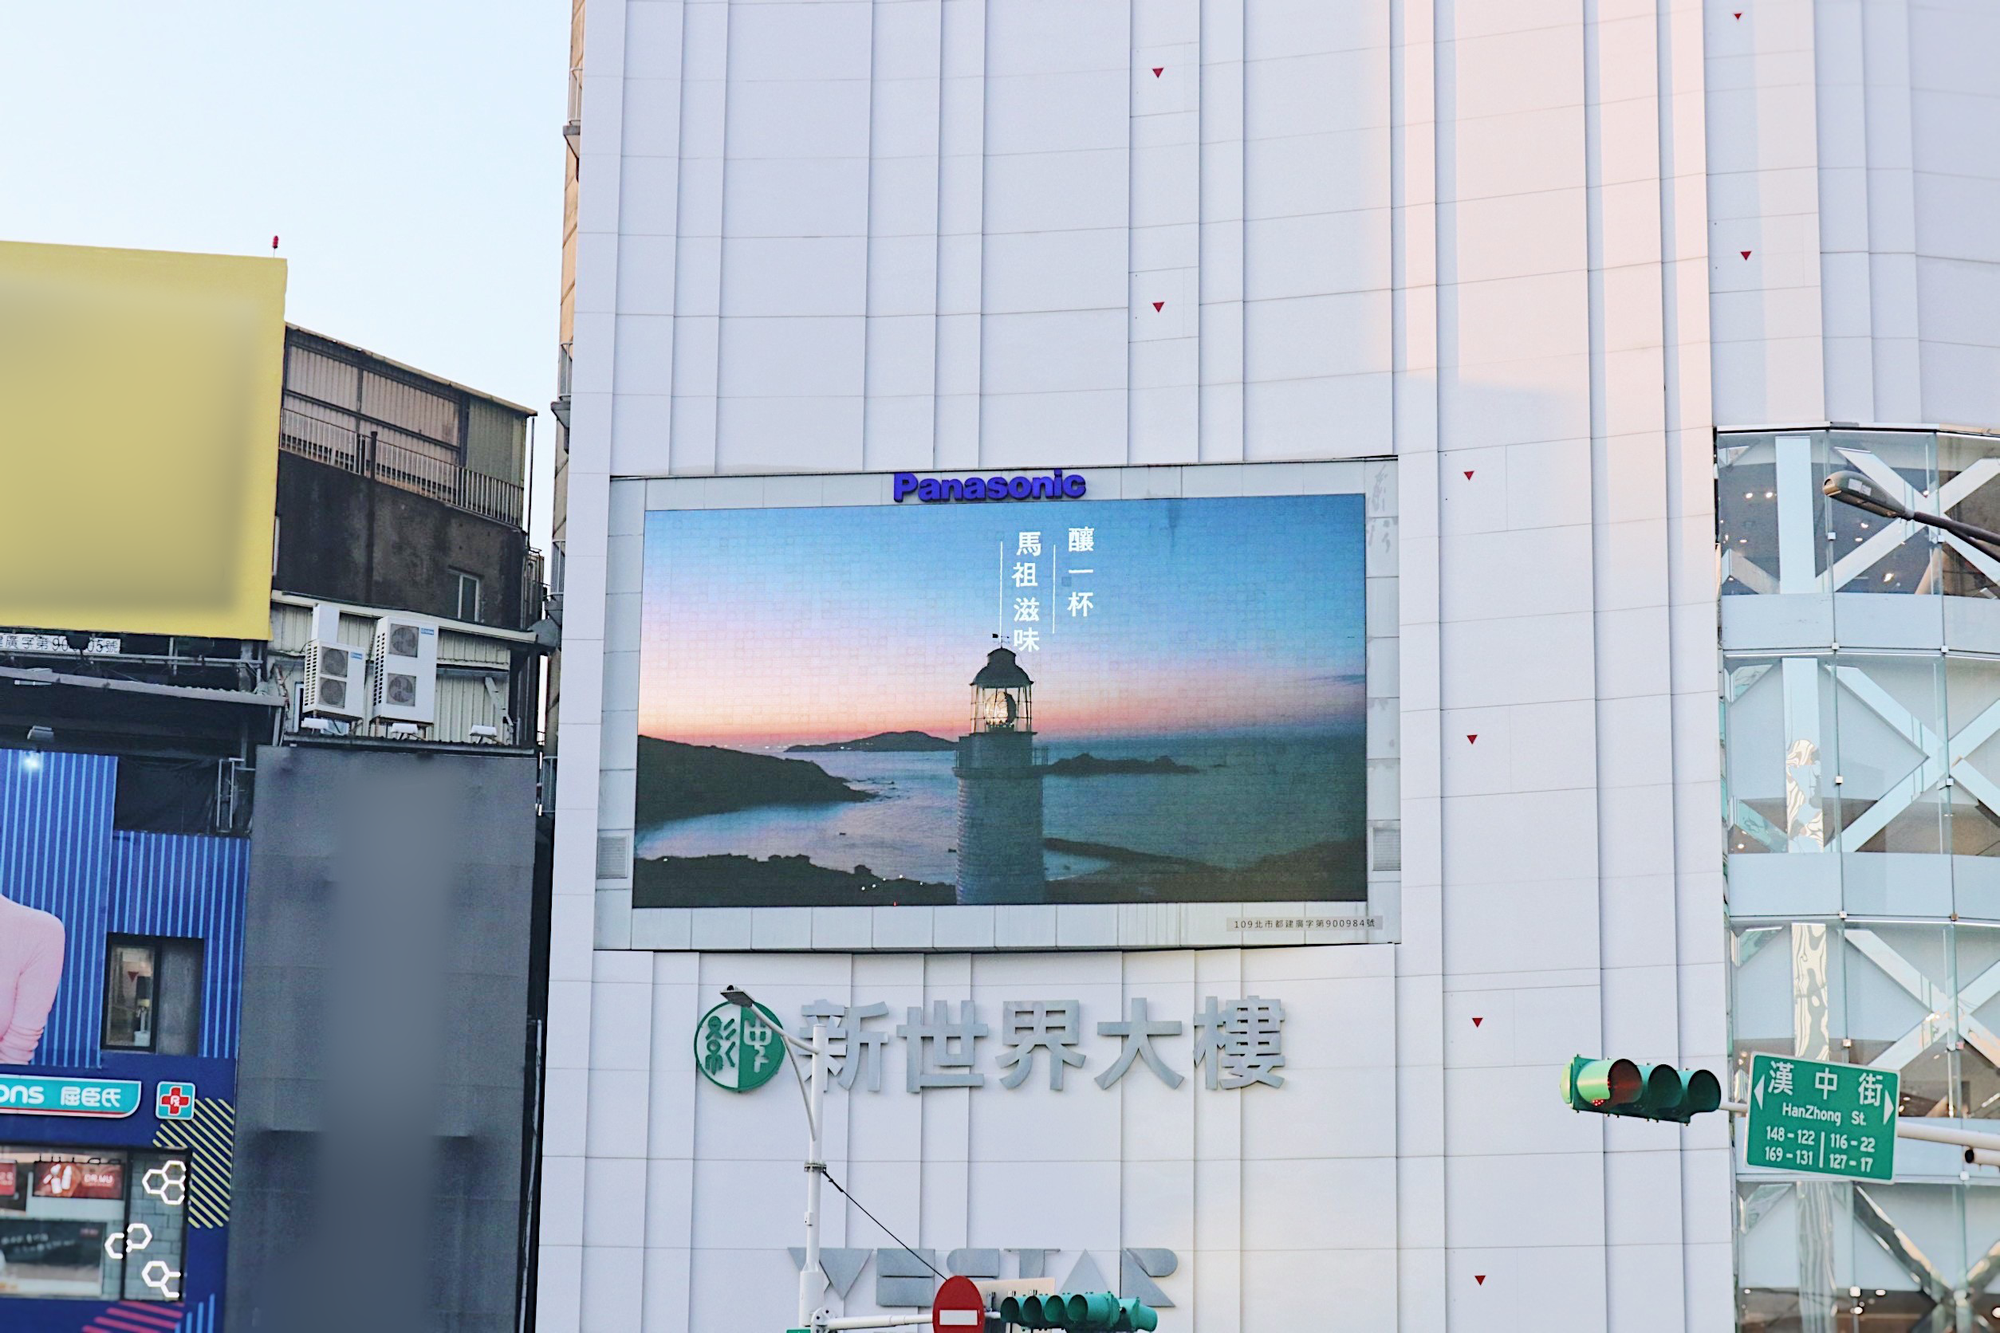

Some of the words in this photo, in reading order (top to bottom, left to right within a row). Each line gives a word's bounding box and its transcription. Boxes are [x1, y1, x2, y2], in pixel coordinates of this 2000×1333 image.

[894, 469, 1086, 502] Panasonic
[1011, 531, 1042, 652] 馬祖滋味
[1067, 526, 1095, 617] 釀一杯
[799, 995, 1286, 1093] 新世界大樓
[60, 1086, 122, 1108] 屈臣氏
[1767, 1060, 1883, 1107] 漢中街
[1782, 1102, 1842, 1127] HanZhong
[1851, 1110, 1867, 1126] St.
